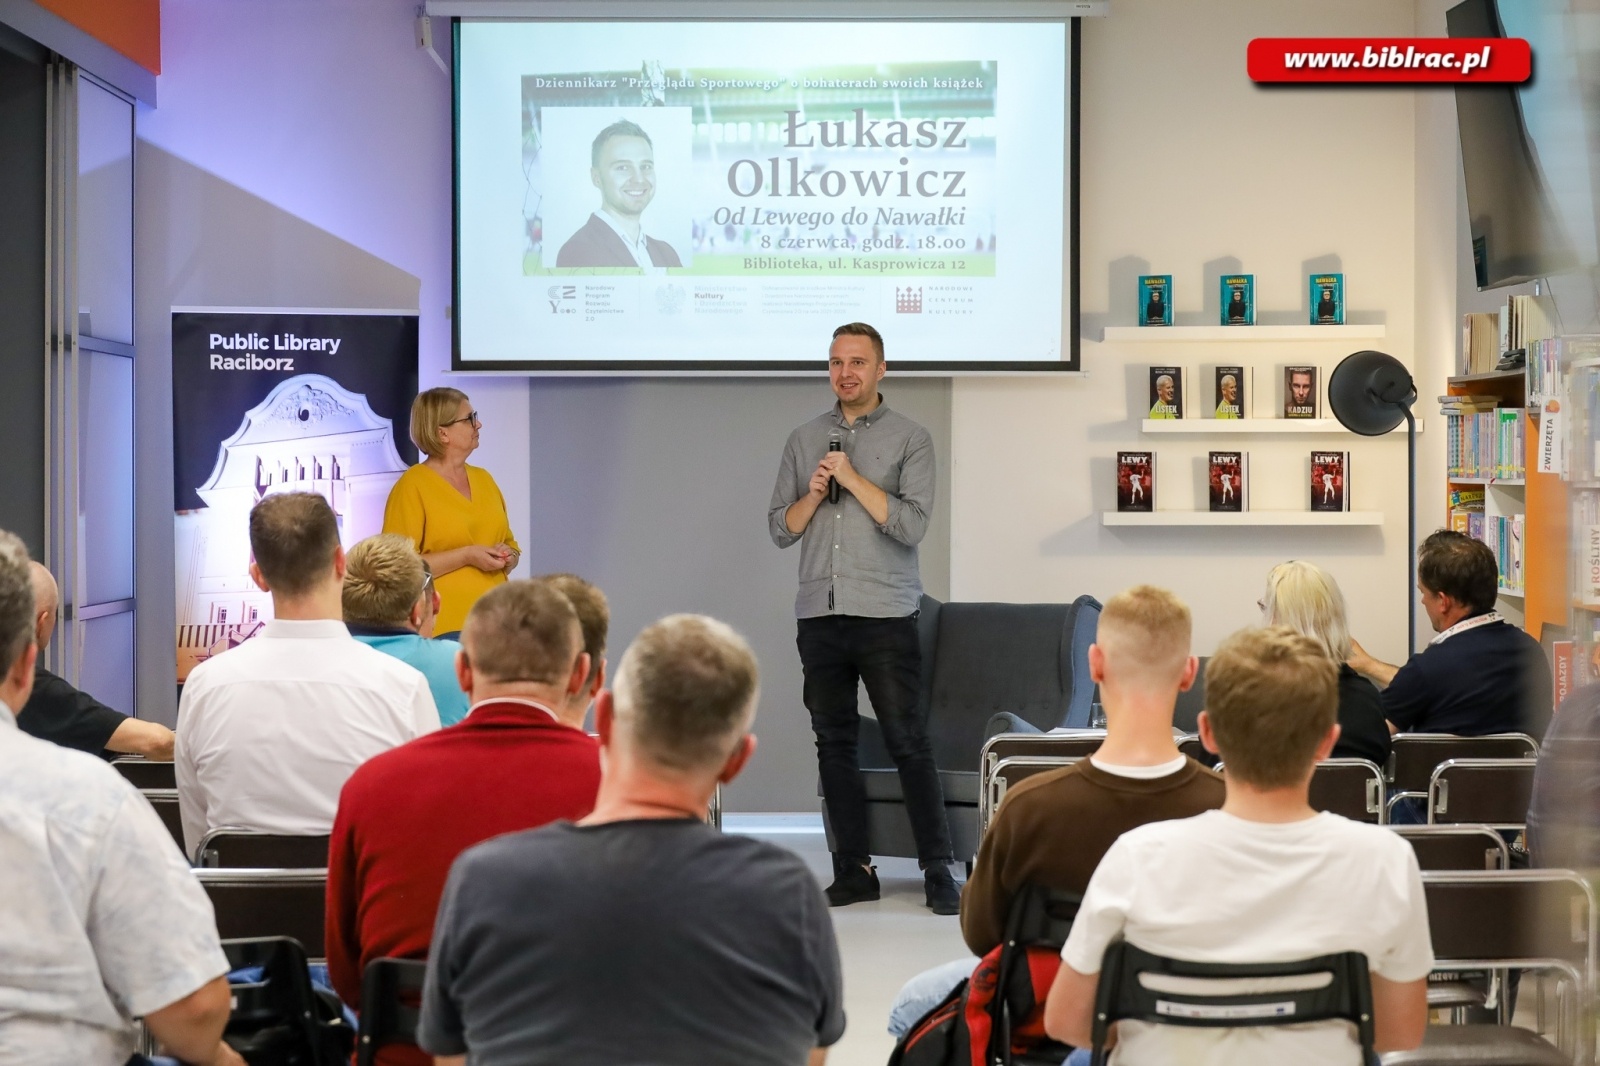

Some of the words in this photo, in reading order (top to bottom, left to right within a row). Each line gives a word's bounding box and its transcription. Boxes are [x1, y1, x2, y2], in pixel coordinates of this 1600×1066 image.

[535, 77, 617, 88] Dziennikarz
[622, 77, 695, 90] "Przeglądu
[700, 77, 786, 90] Sportowego"
[790, 80, 798, 88] o
[803, 78, 878, 88] bohaterach
[882, 78, 928, 88] swoich
[933, 77, 984, 90] książek
[783, 108, 967, 148] Łukasz
[727, 156, 966, 198] Olkowicz
[713, 206, 746, 226] Od
[751, 206, 835, 230] Lewego
[841, 206, 868, 226] do
[874, 206, 966, 226] Nawałki
[760, 235, 772, 249] 8
[778, 238, 856, 251] czerwca,
[862, 234, 910, 252] godz.
[916, 234, 966, 250] 18.00
[743, 257, 823, 271] Biblioteka,
[828, 257, 848, 270] ul.
[852, 258, 946, 272] Kasprowicza
[951, 260, 966, 270] 12
[209, 332, 270, 350] Public
[274, 332, 342, 355] Library
[210, 352, 295, 370] Raciborz
[1155, 404, 1178, 414] LISTEK
[1220, 405, 1240, 414] LISTEK
[1544, 418, 1554, 471] ZWIERZĘTA
[1588, 528, 1600, 584] ROŚLINY
